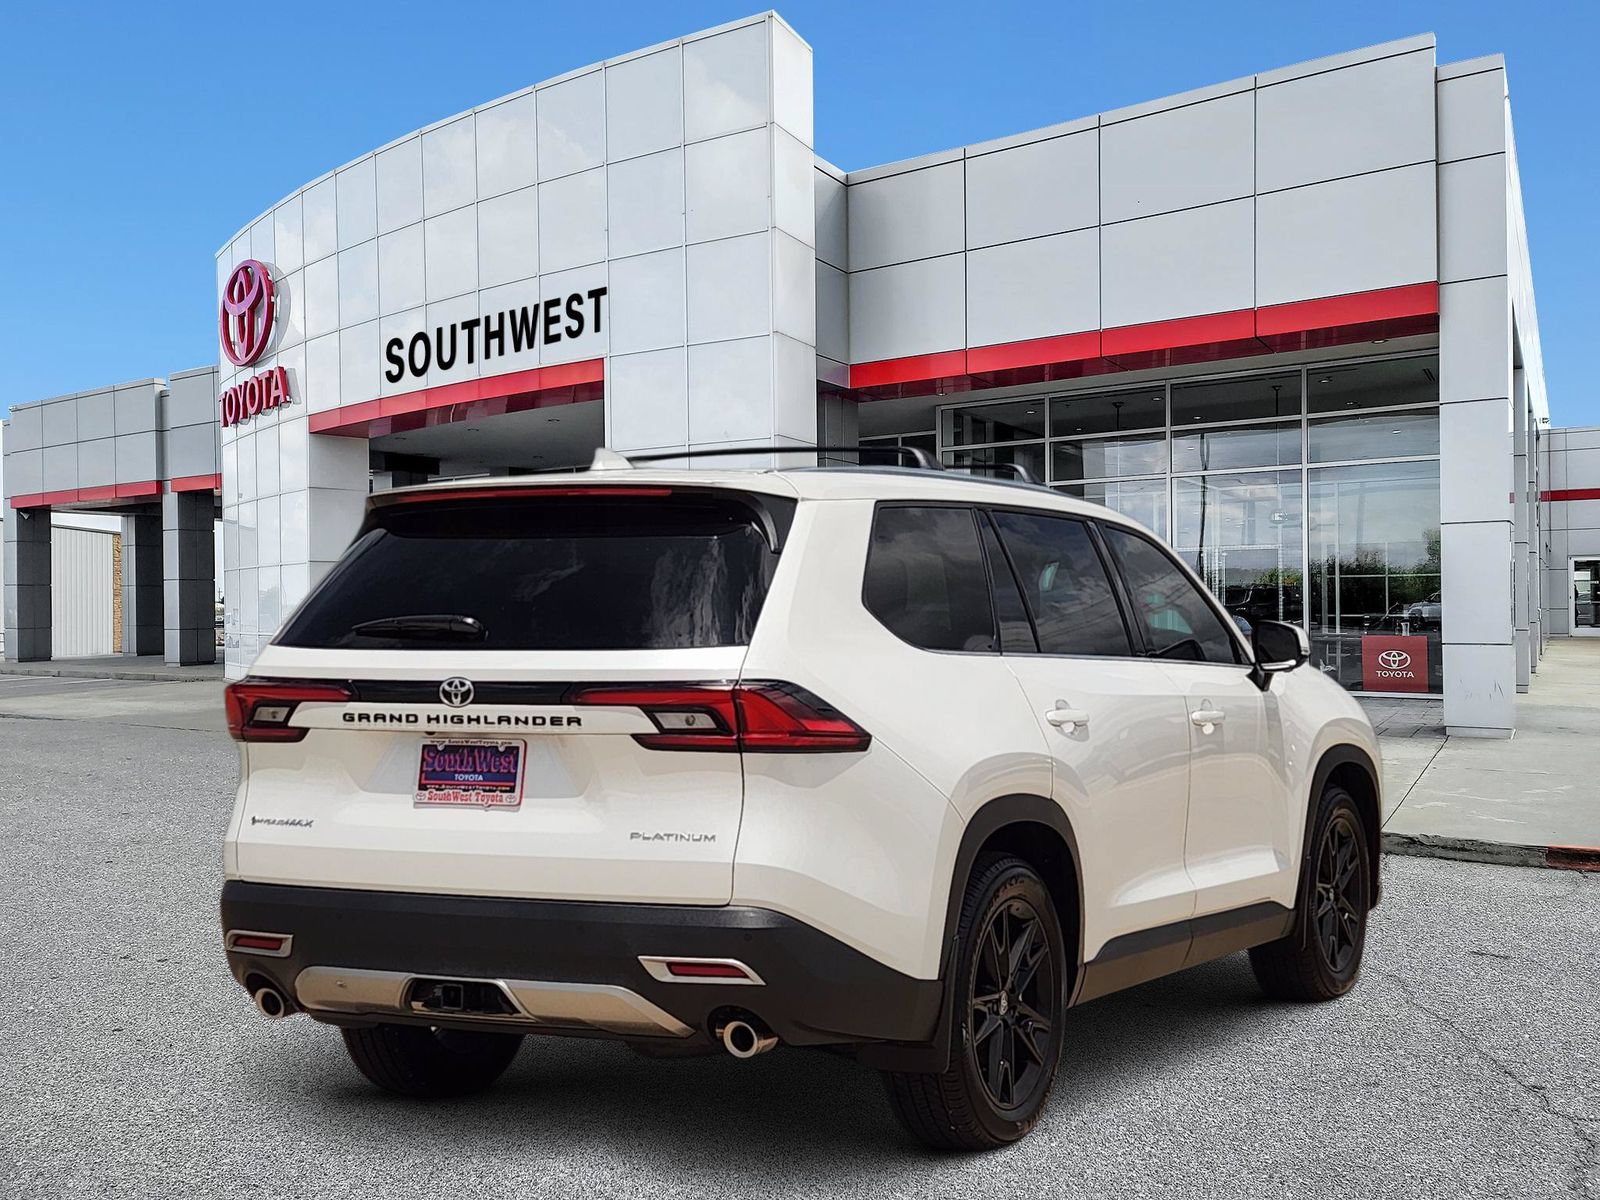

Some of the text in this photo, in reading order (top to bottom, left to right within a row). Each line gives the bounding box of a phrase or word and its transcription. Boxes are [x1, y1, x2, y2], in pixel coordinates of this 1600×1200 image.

[385, 287, 608, 383] SOUTHWEST
[219, 366, 289, 427] TOYOTA
[1376, 670, 1414, 678] TOYOTA
[342, 713, 582, 726] GRAND HIGHLANDER
[630, 832, 716, 841] PLATINUM
